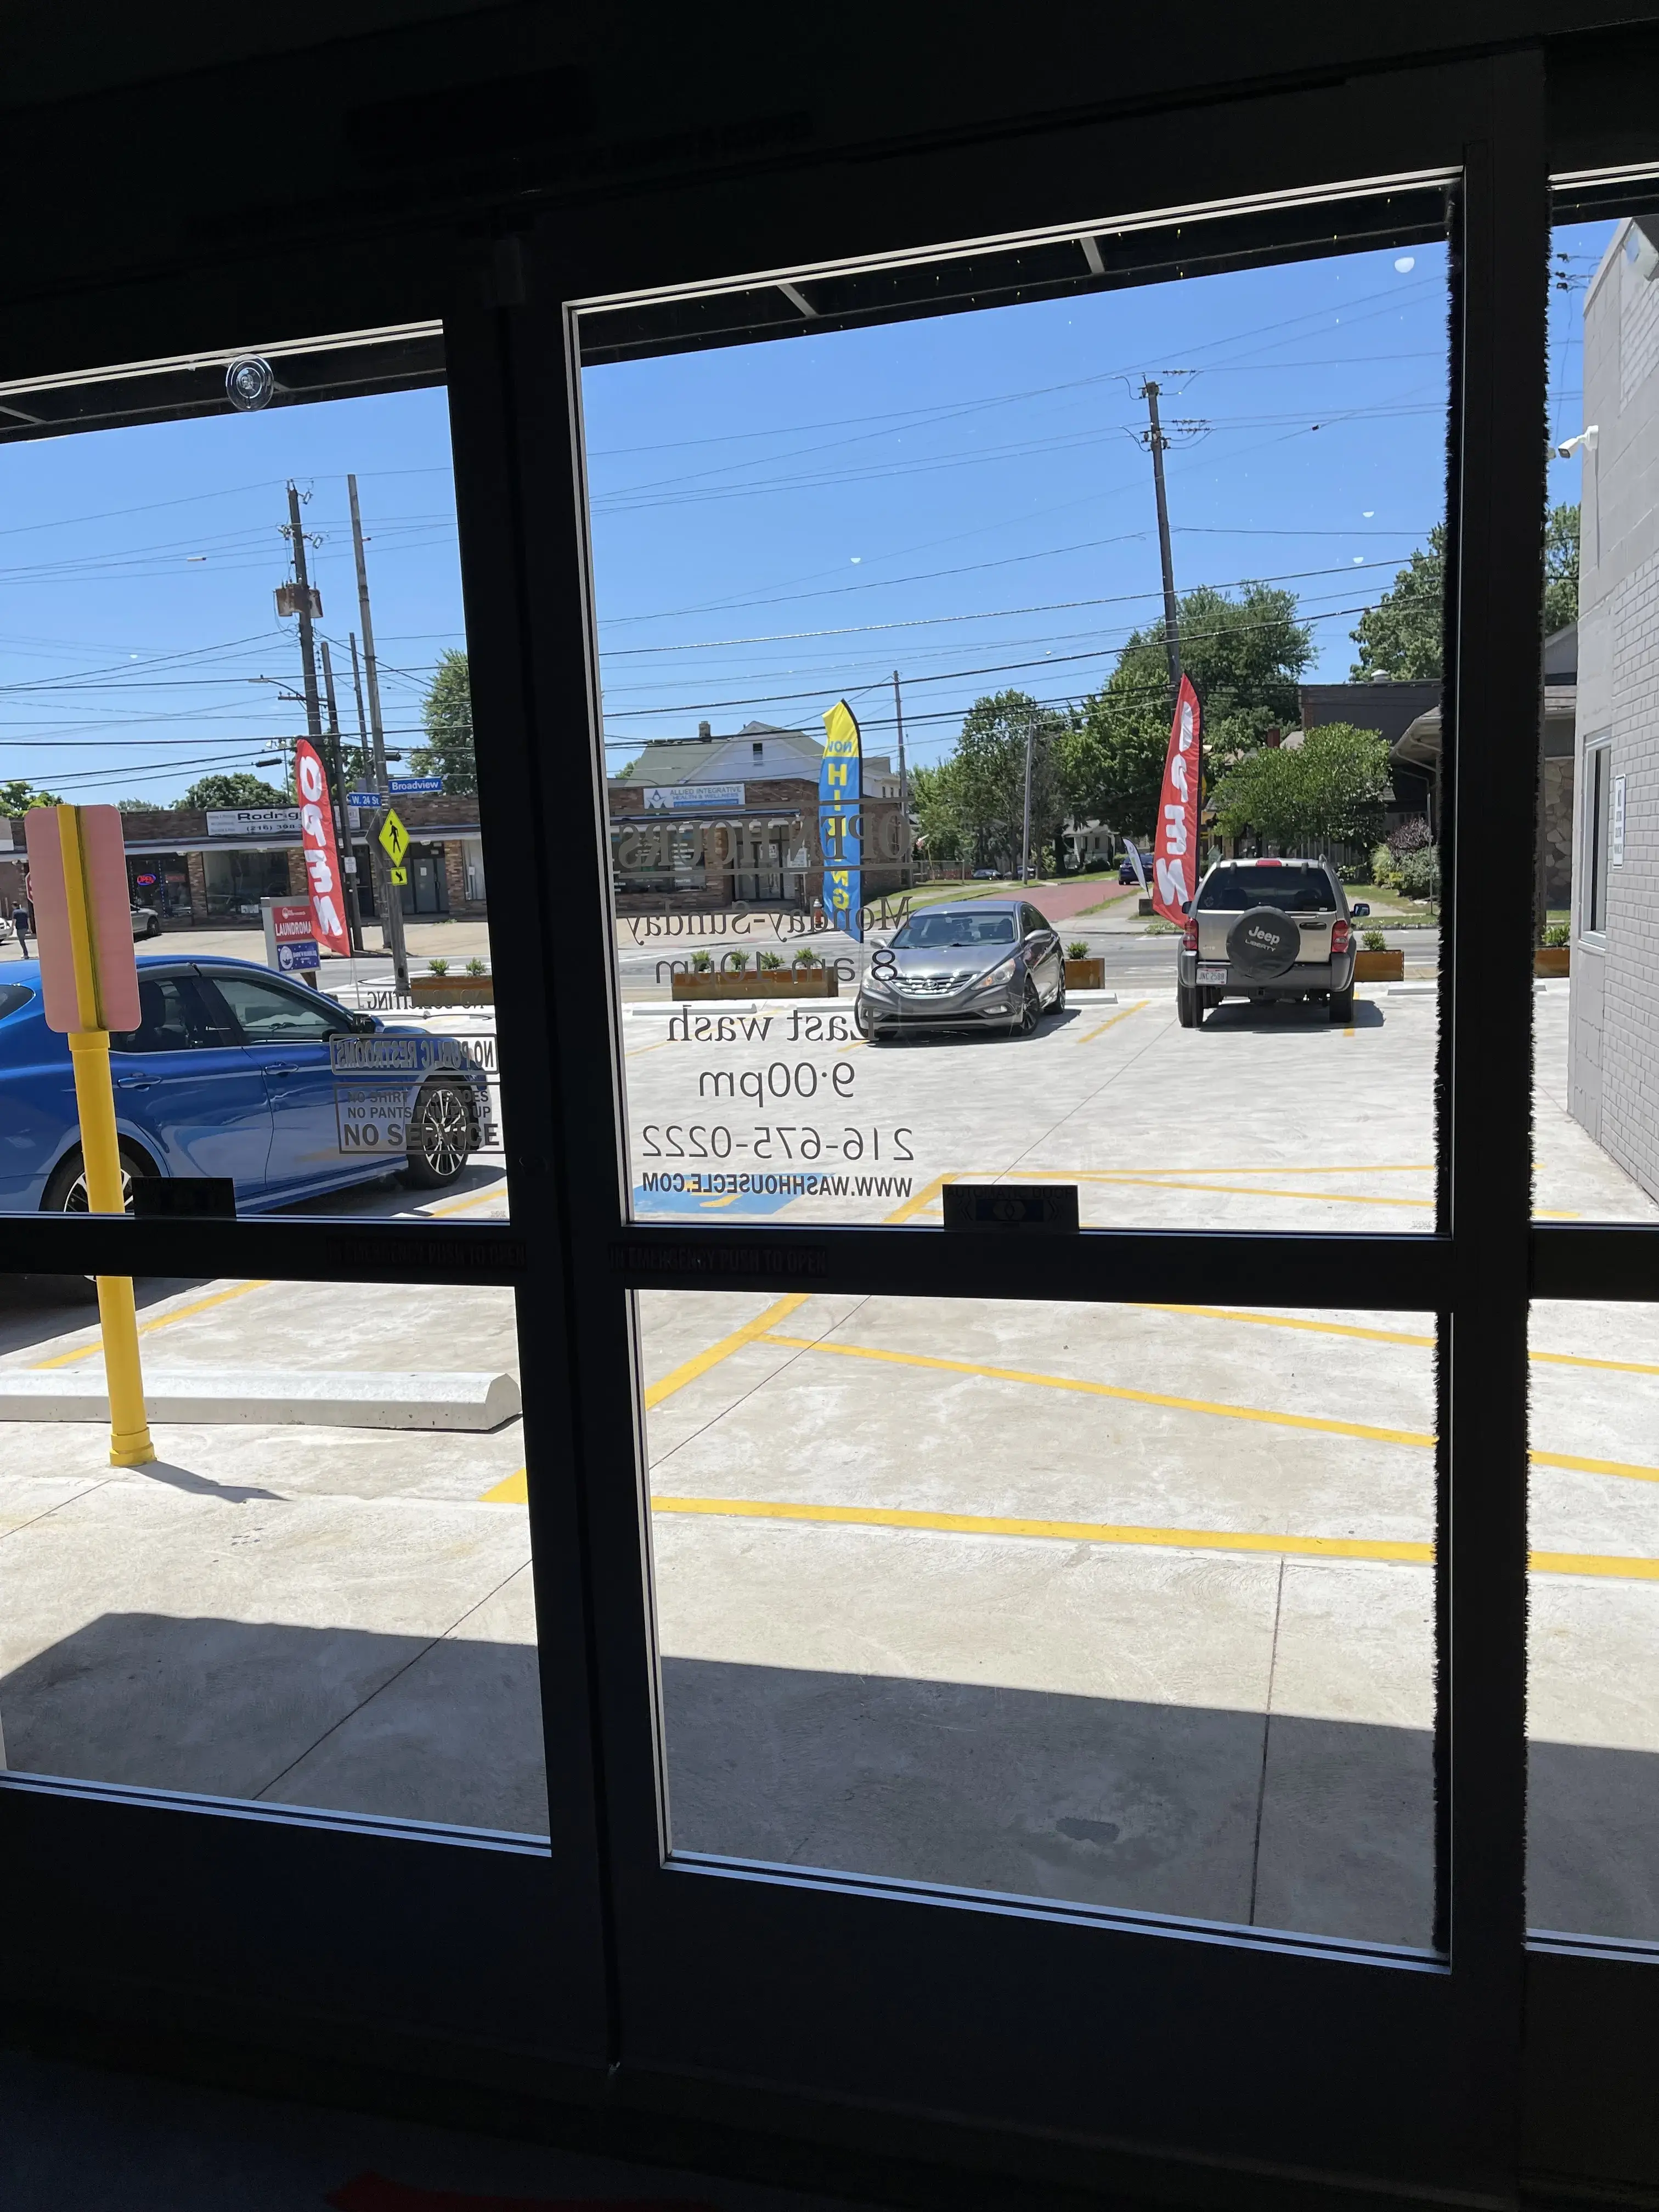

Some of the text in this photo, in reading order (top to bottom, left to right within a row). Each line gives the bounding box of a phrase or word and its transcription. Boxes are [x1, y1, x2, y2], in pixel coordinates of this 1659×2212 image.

[391, 781, 439, 791] Broadview
[696, 786, 742, 794] INTEGRATIVE
[352, 795, 380, 805] W. 24 St
[238, 811, 301, 821] Rodrig
[275, 921, 312, 936] LAUNDROMA
[1248, 926, 1280, 945] Jeep
[1245, 939, 1277, 952] LIBERTY
[347, 1091, 365, 1103] NO
[370, 1090, 409, 1103] SHIRT
[348, 1107, 366, 1119] NO
[370, 1106, 412, 1119] PANTS
[472, 1106, 491, 1118] UP
[343, 1123, 500, 1147] NO SERVICE
